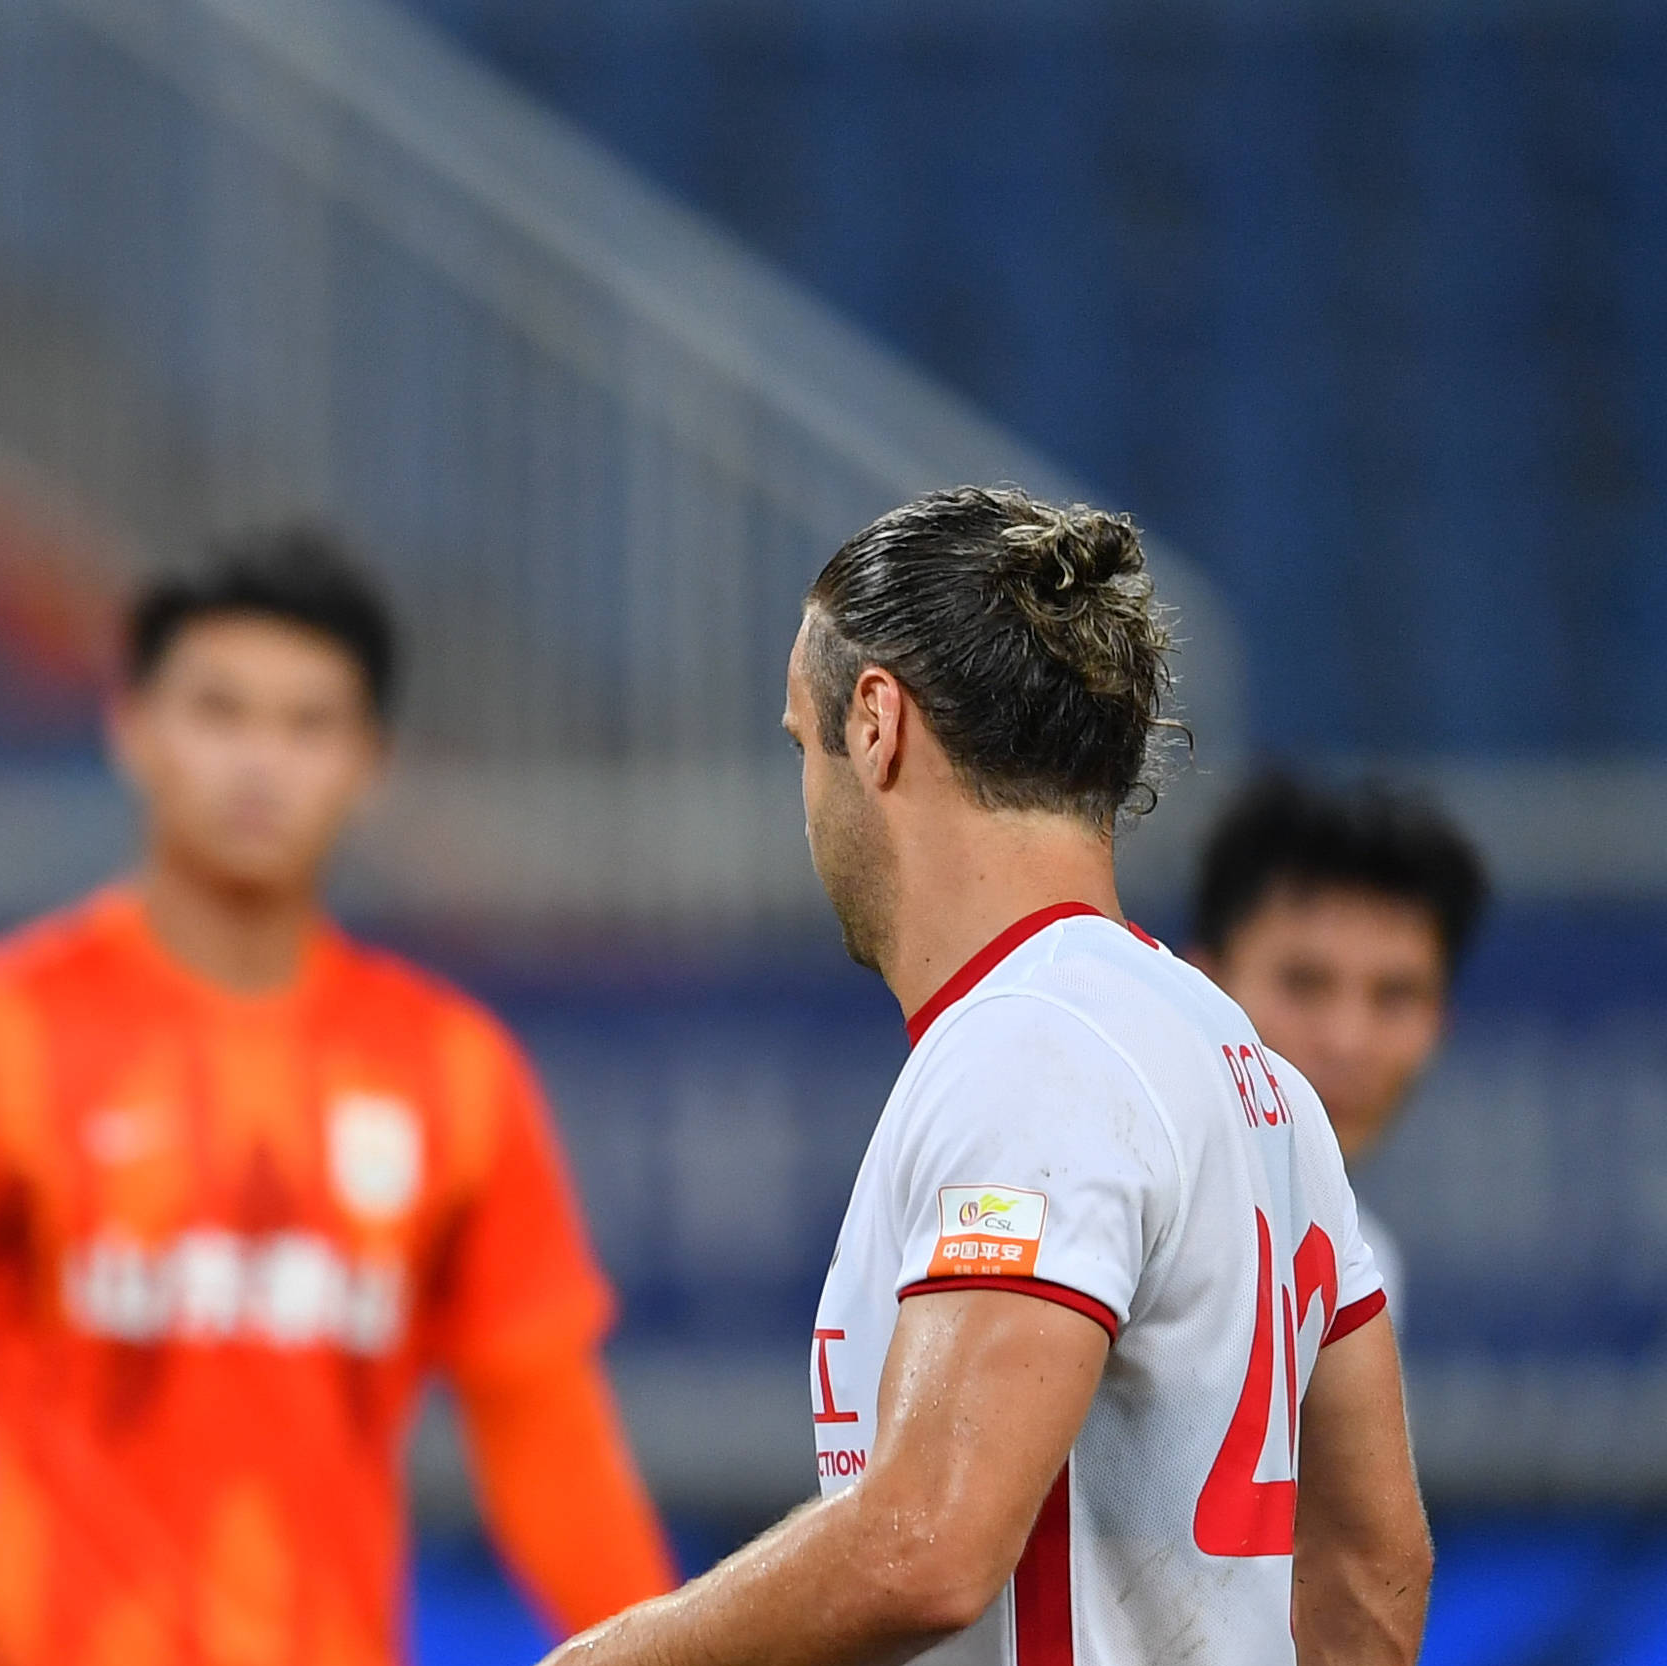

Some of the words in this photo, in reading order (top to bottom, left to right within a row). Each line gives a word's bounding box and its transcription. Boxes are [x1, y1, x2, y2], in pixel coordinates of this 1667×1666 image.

[984, 1217, 1015, 1232] CSL
[942, 1241, 1024, 1261] 中国平安
